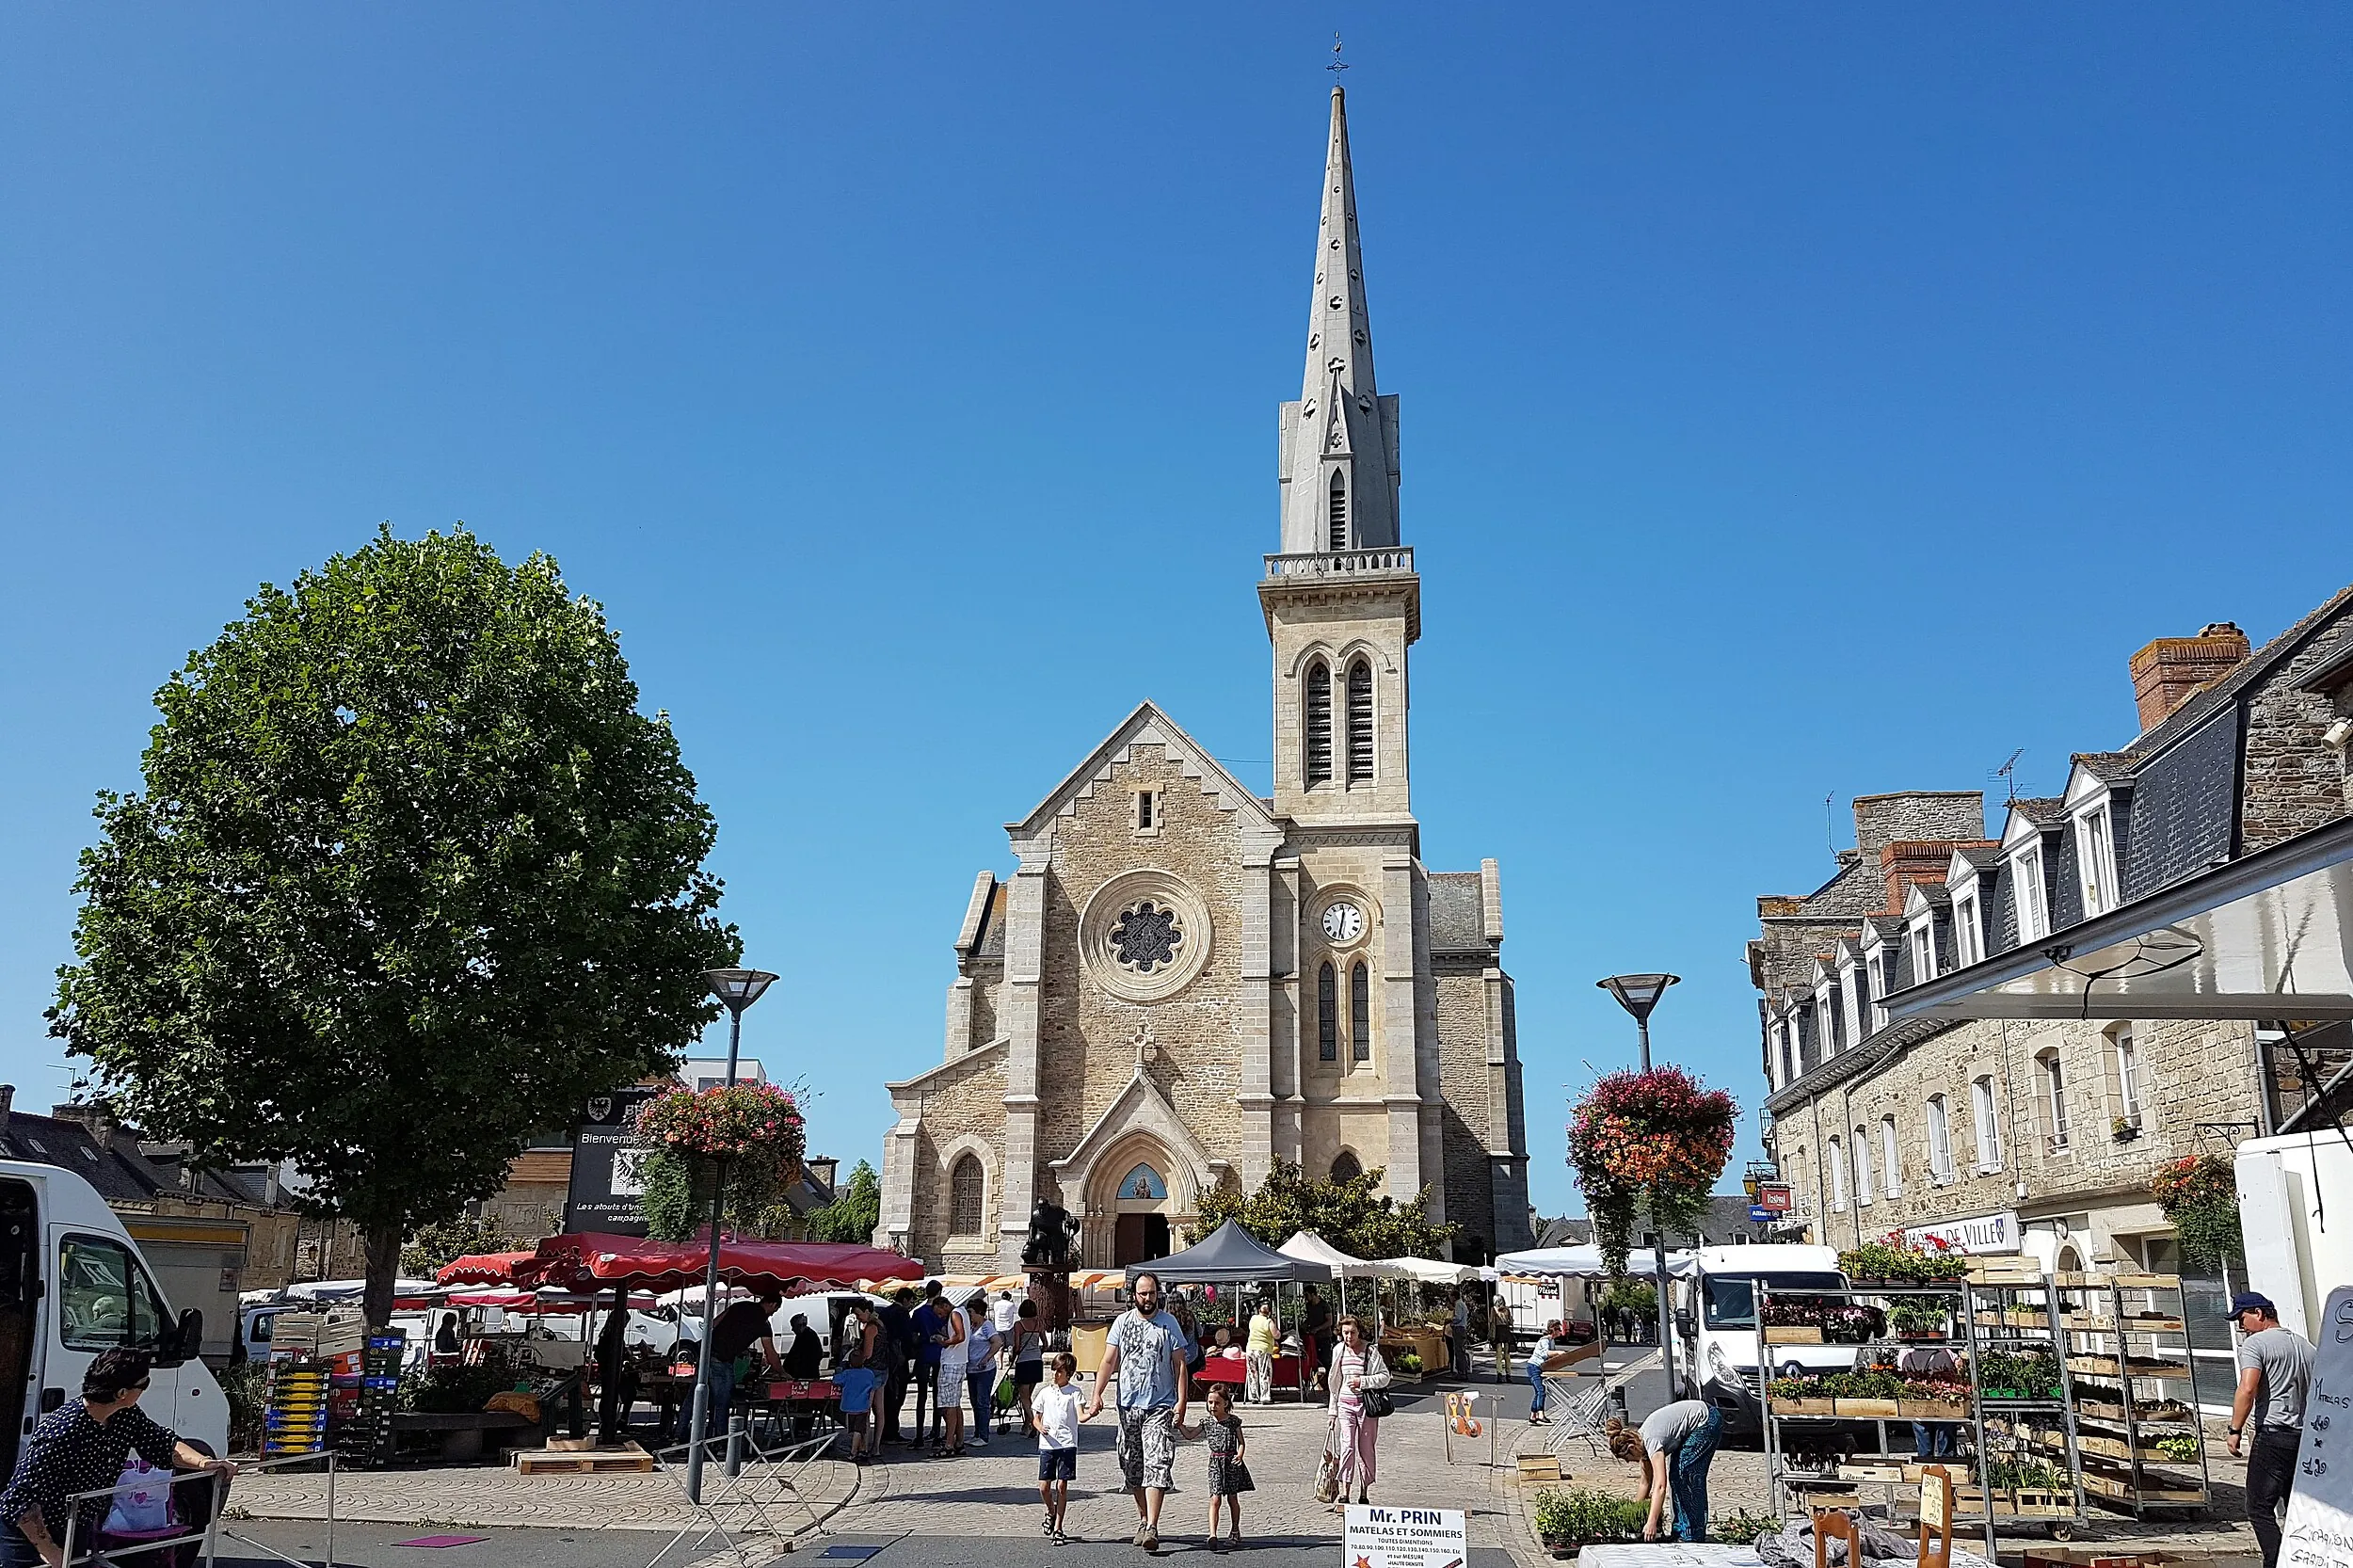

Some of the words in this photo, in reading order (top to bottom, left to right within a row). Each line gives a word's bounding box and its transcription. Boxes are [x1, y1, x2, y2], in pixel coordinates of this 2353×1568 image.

[582, 1133, 640, 1144] Bienvenue
[576, 1202, 592, 1210] Les
[1369, 1509, 1397, 1523] Mr.
[1401, 1510, 1442, 1526] PRIN
[1350, 1526, 1394, 1536] MATELAS
[1397, 1528, 1408, 1536] ET
[1410, 1528, 1463, 1539] SOMMIERS
